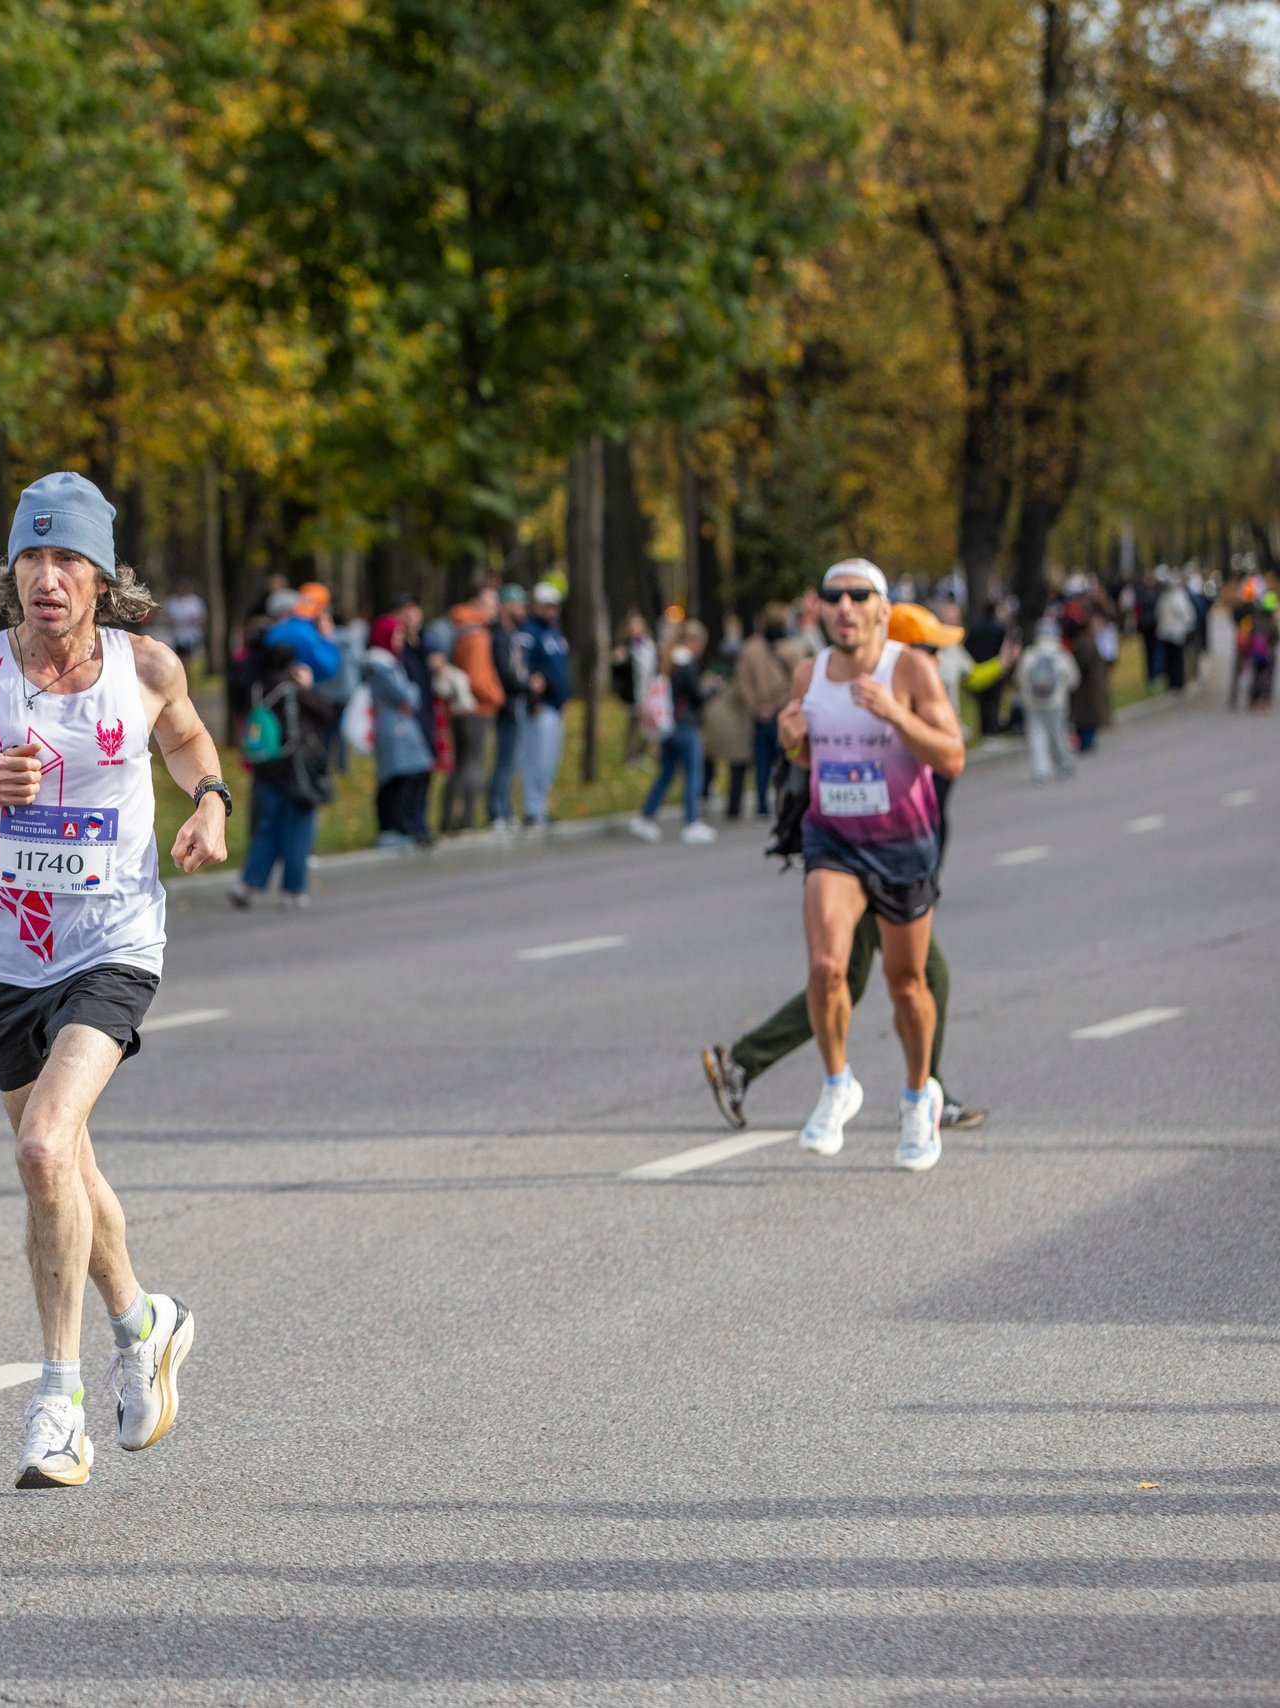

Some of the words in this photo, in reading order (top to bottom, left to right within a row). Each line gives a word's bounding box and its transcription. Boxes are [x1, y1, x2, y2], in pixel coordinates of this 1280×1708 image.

[15, 819, 47, 827] ПОЛУМАРАФОН
[10, 824, 24, 832] МОЯ
[24, 826, 57, 835] СТОЛИЦА
[15, 850, 84, 875] 11740
